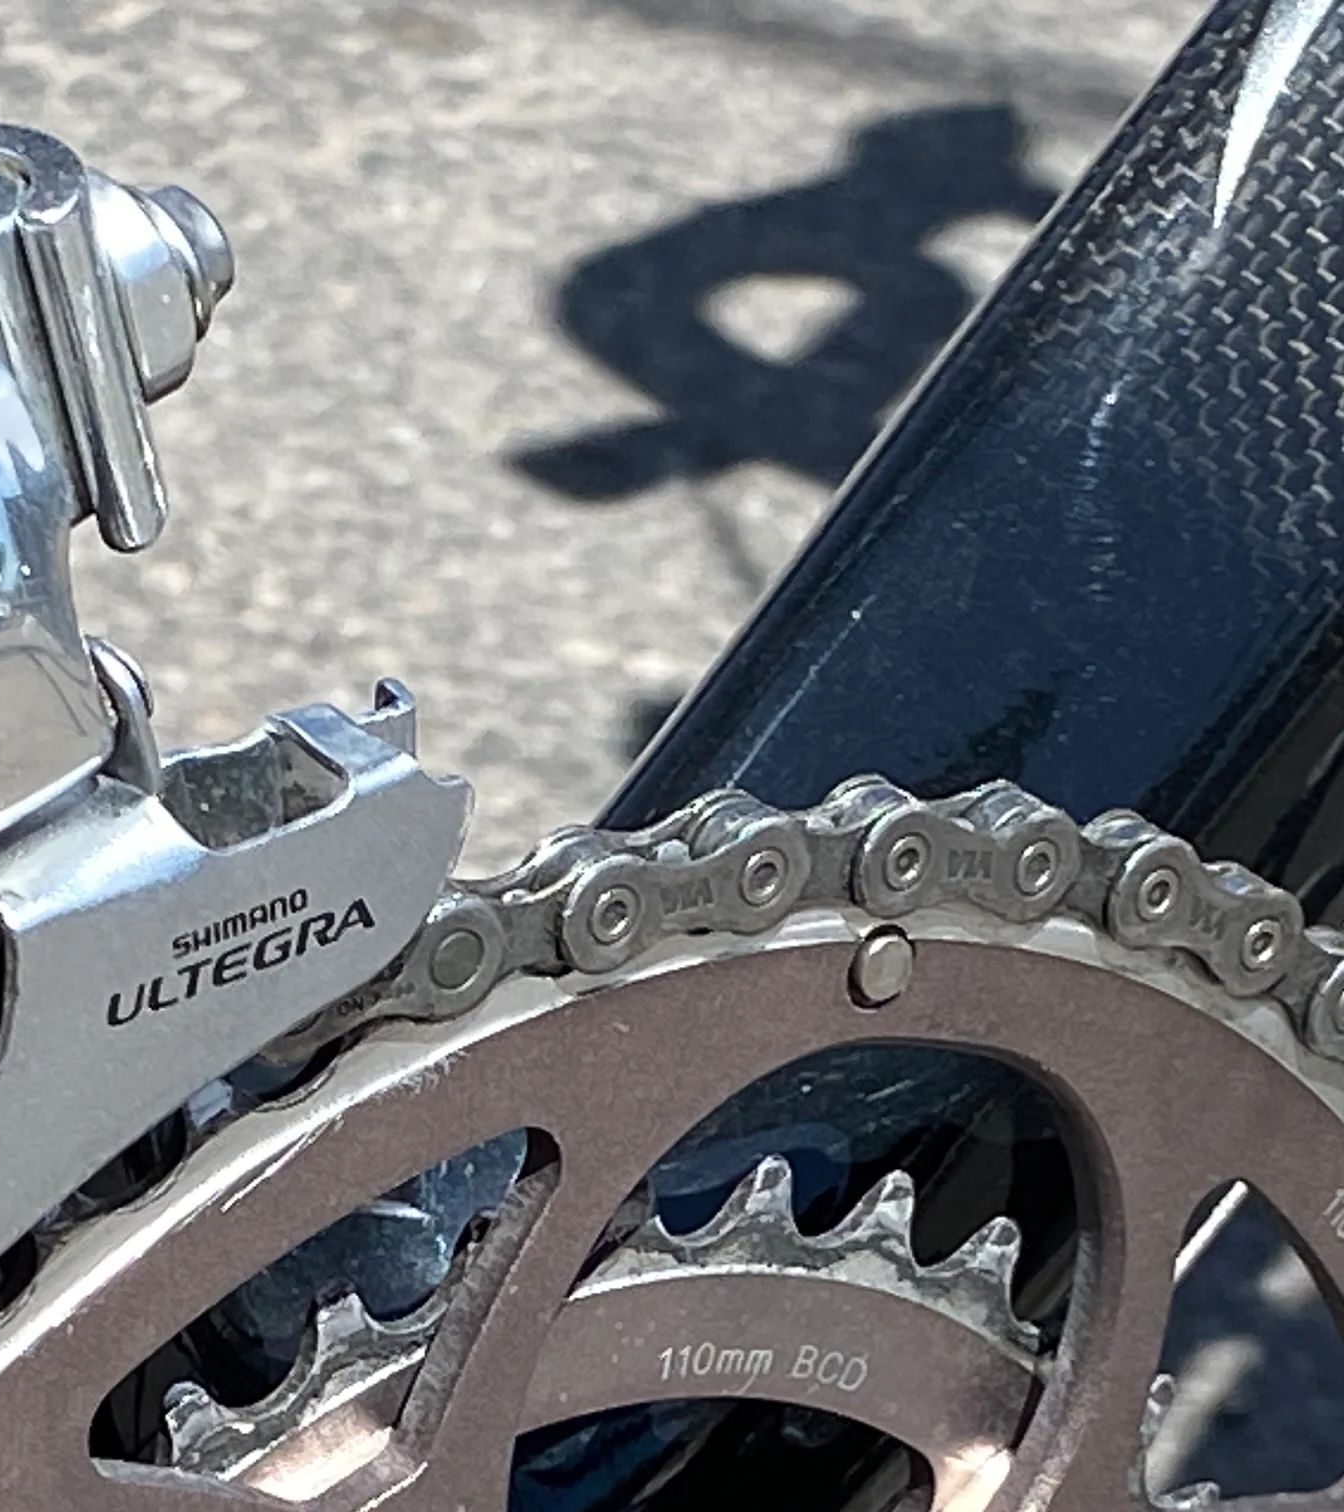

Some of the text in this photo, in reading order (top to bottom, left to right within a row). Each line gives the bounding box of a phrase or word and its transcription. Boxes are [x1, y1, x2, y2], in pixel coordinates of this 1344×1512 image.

[172, 888, 310, 959] SHIMANO
[106, 897, 376, 1027] ULTEGRA
[657, 1341, 869, 1393] 110mm BCD
